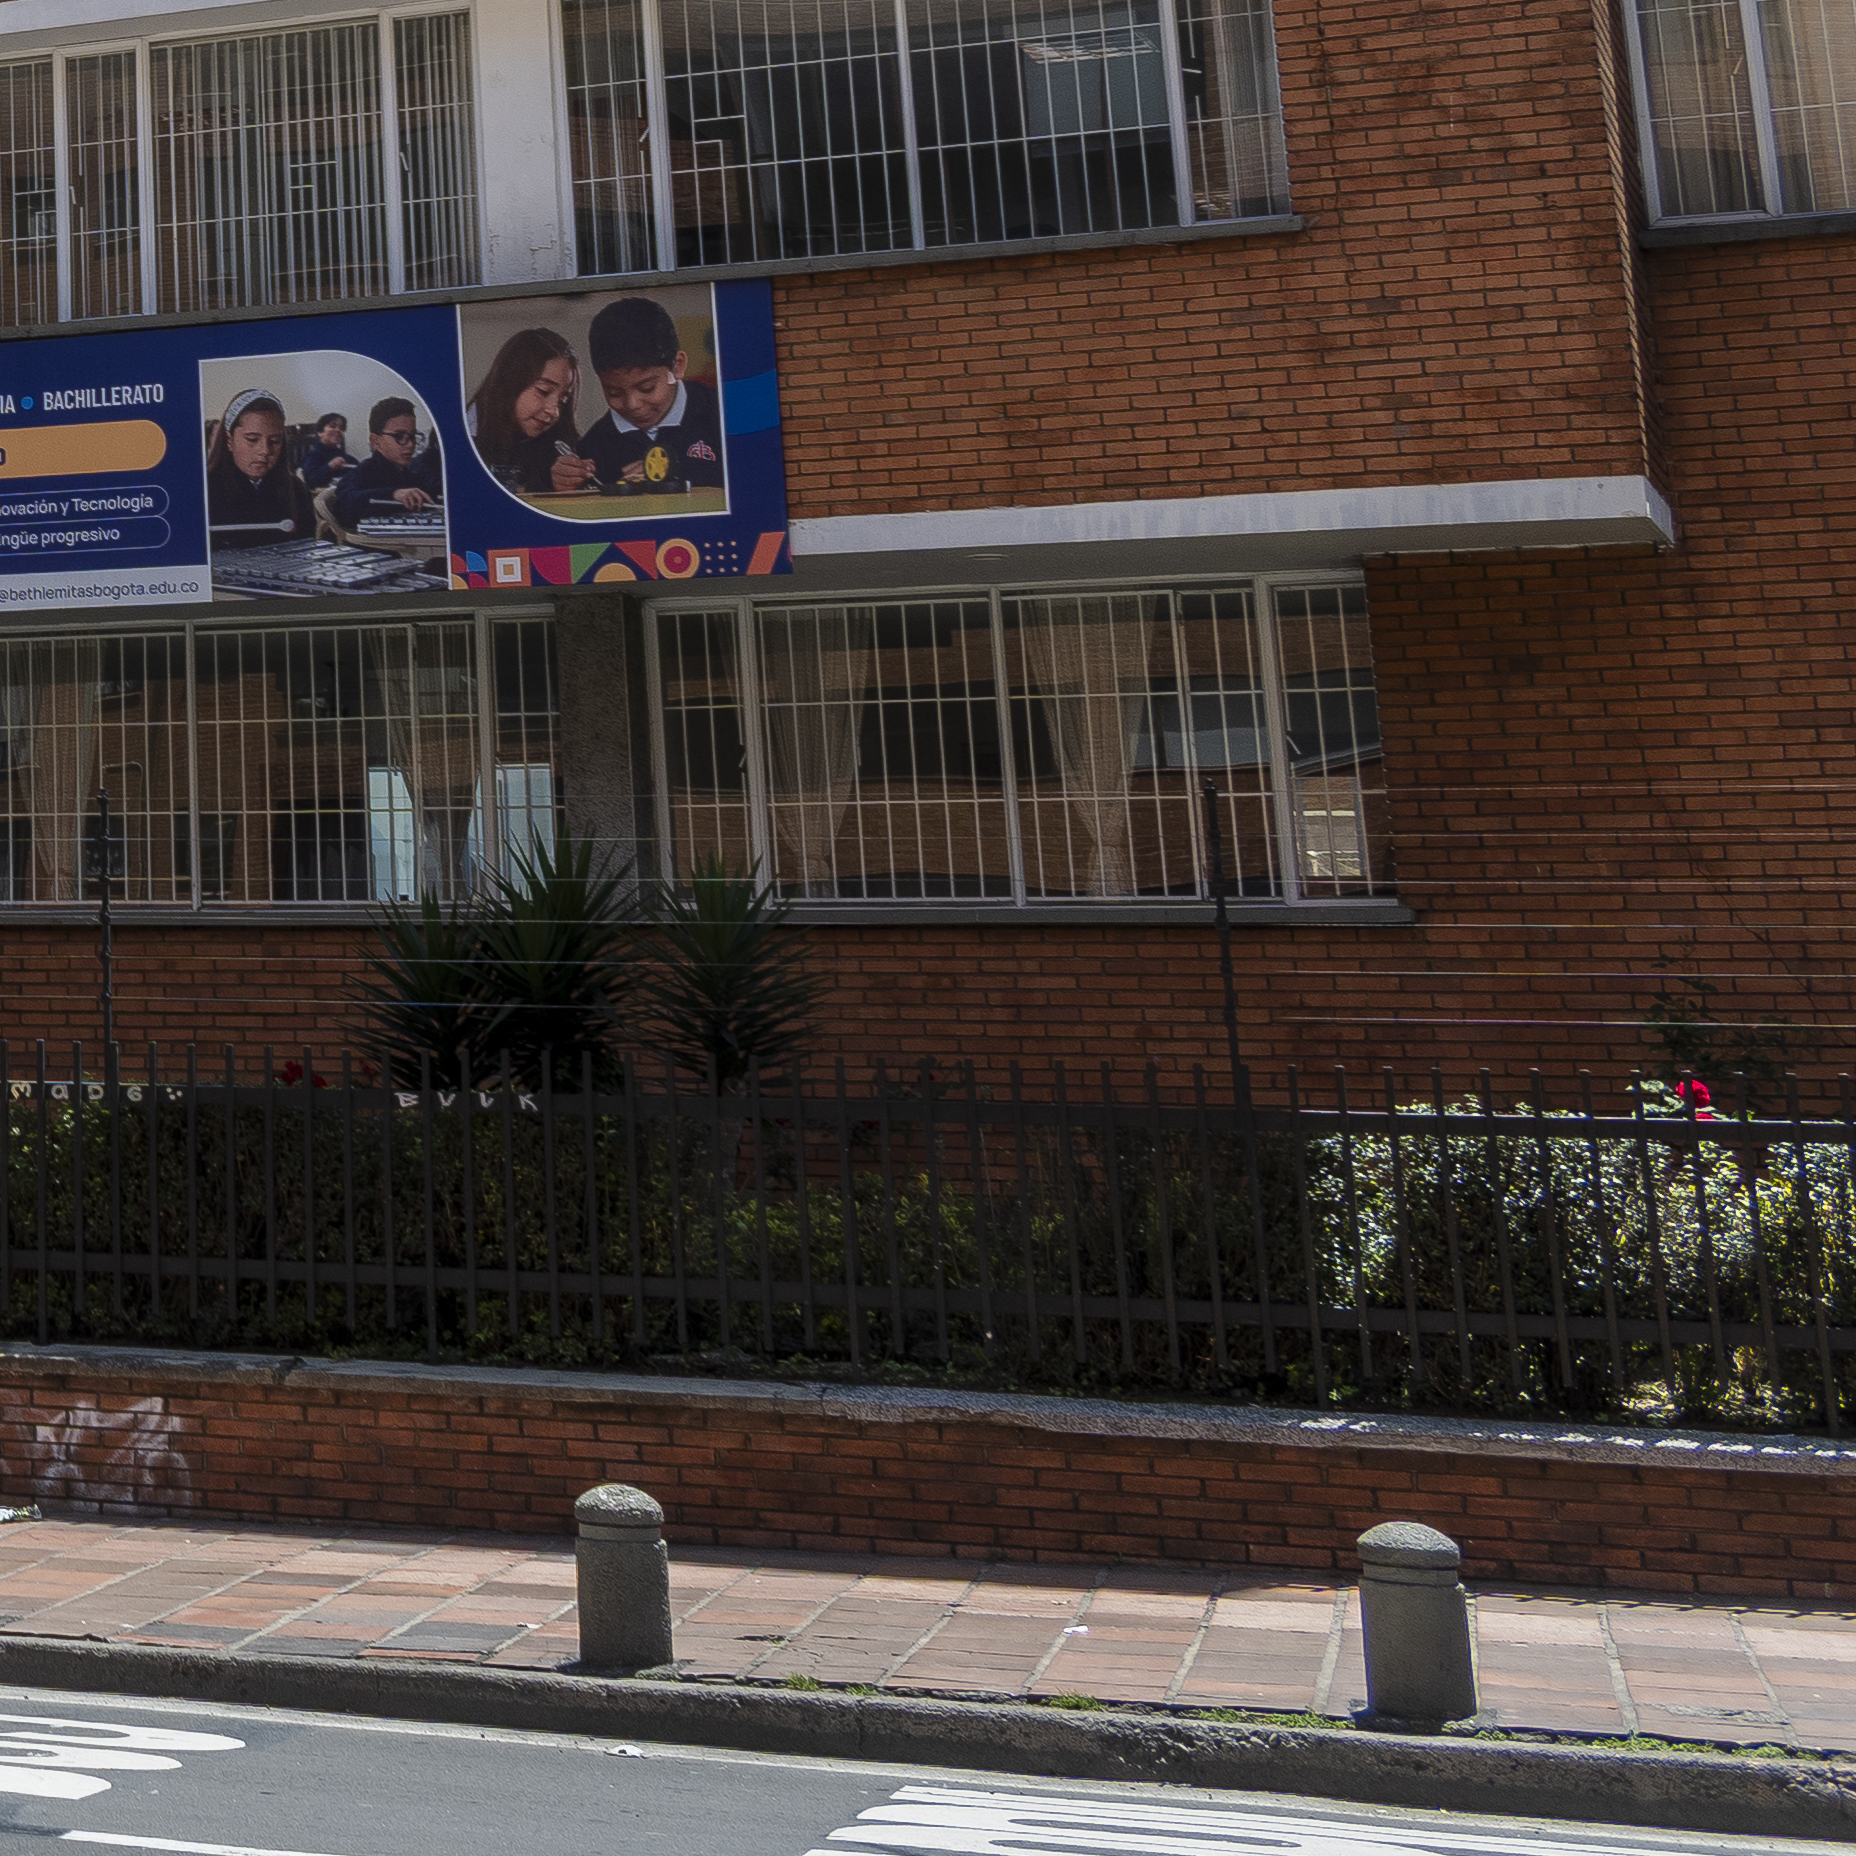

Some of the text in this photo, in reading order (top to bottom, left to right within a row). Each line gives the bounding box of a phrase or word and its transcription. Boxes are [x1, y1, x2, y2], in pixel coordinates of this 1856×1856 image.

[43, 383, 164, 411] BACHILLERATO
[60, 500, 70, 516] y
[71, 492, 154, 513] Tecnología
[41, 526, 121, 548] progresivo
